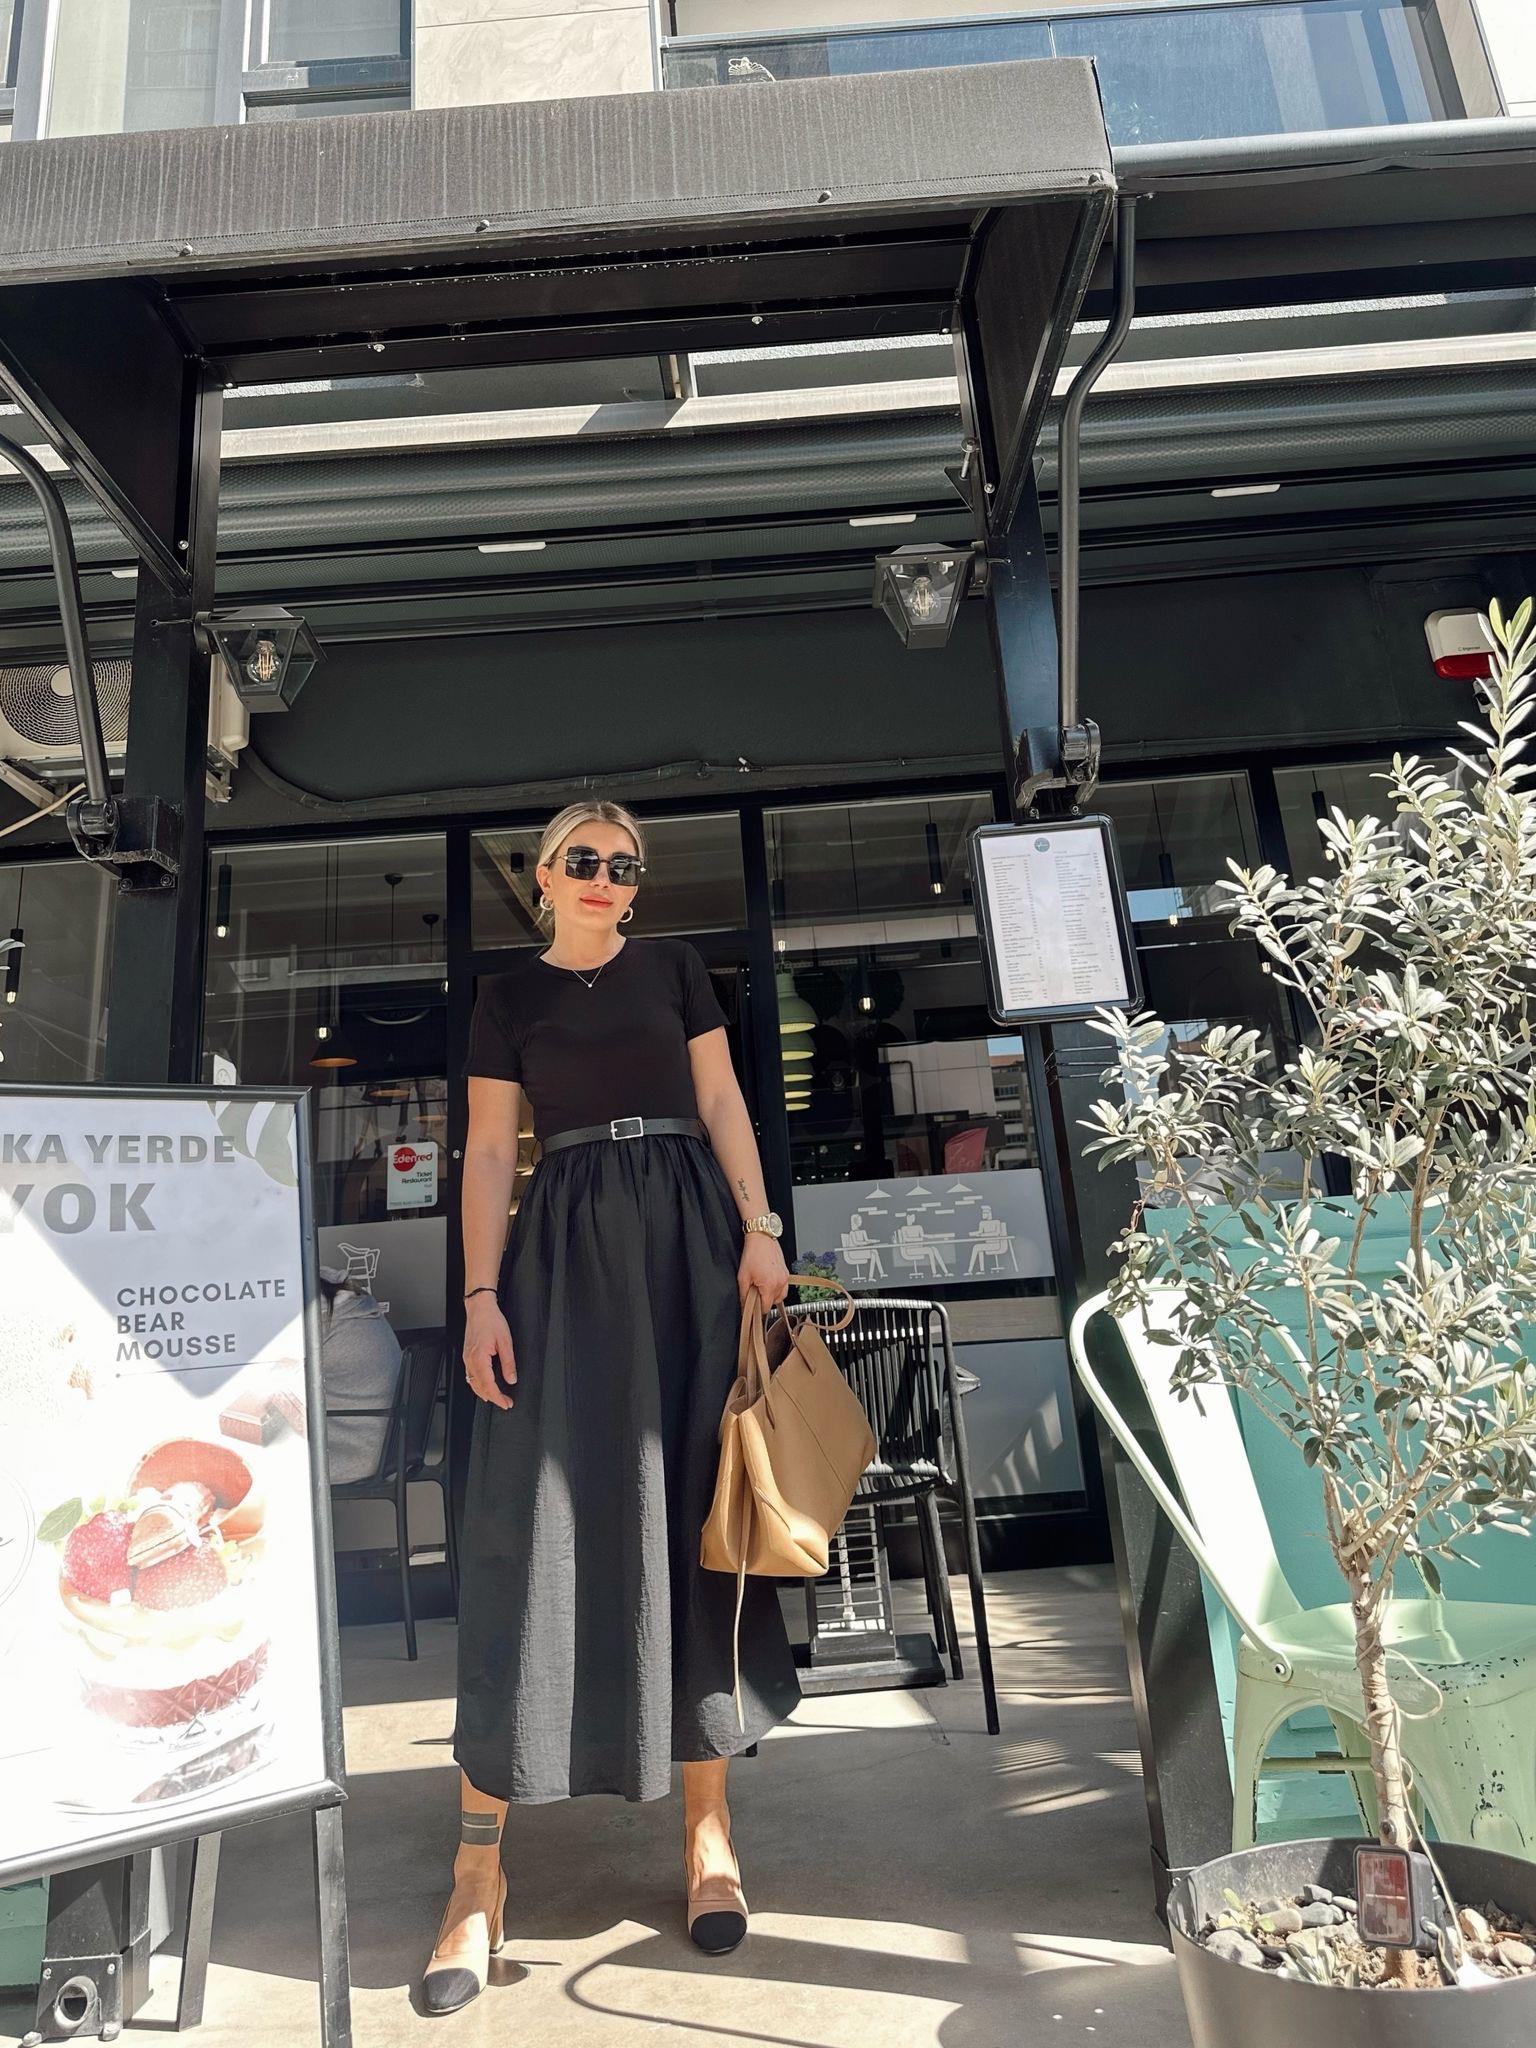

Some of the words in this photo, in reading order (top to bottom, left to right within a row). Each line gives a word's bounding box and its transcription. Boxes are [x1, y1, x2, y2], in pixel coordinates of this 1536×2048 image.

[2, 1133, 68, 1164] KA
[84, 1134, 236, 1164] YERDE
[393, 1152, 432, 1164] Edenred
[116, 1278, 286, 1308] CHOCOLATE
[116, 1311, 185, 1335] BEAR
[115, 1333, 236, 1362] MOUSSE
